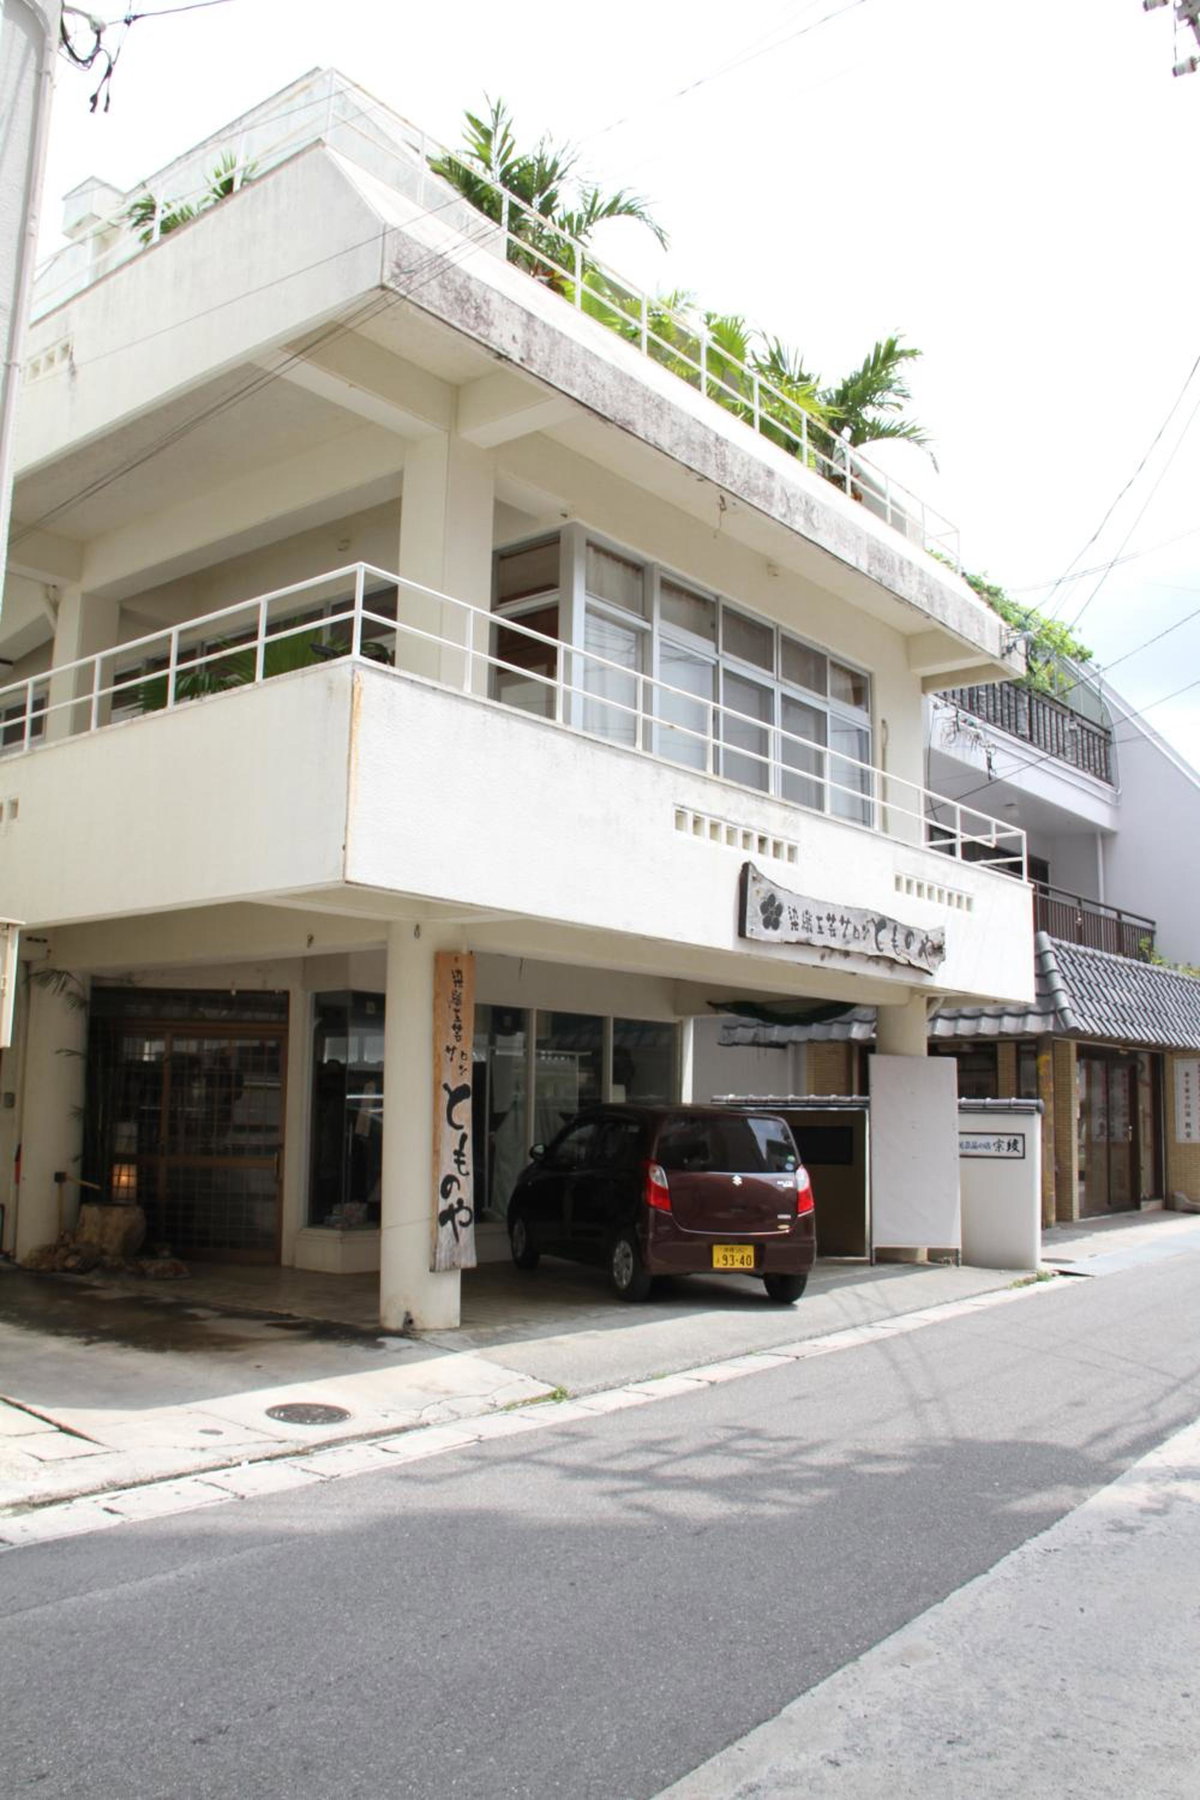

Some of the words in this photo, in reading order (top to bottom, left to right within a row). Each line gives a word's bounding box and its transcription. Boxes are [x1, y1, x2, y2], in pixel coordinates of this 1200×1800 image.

[866, 917, 935, 967] とものや
[439, 1082, 473, 1244] とものや
